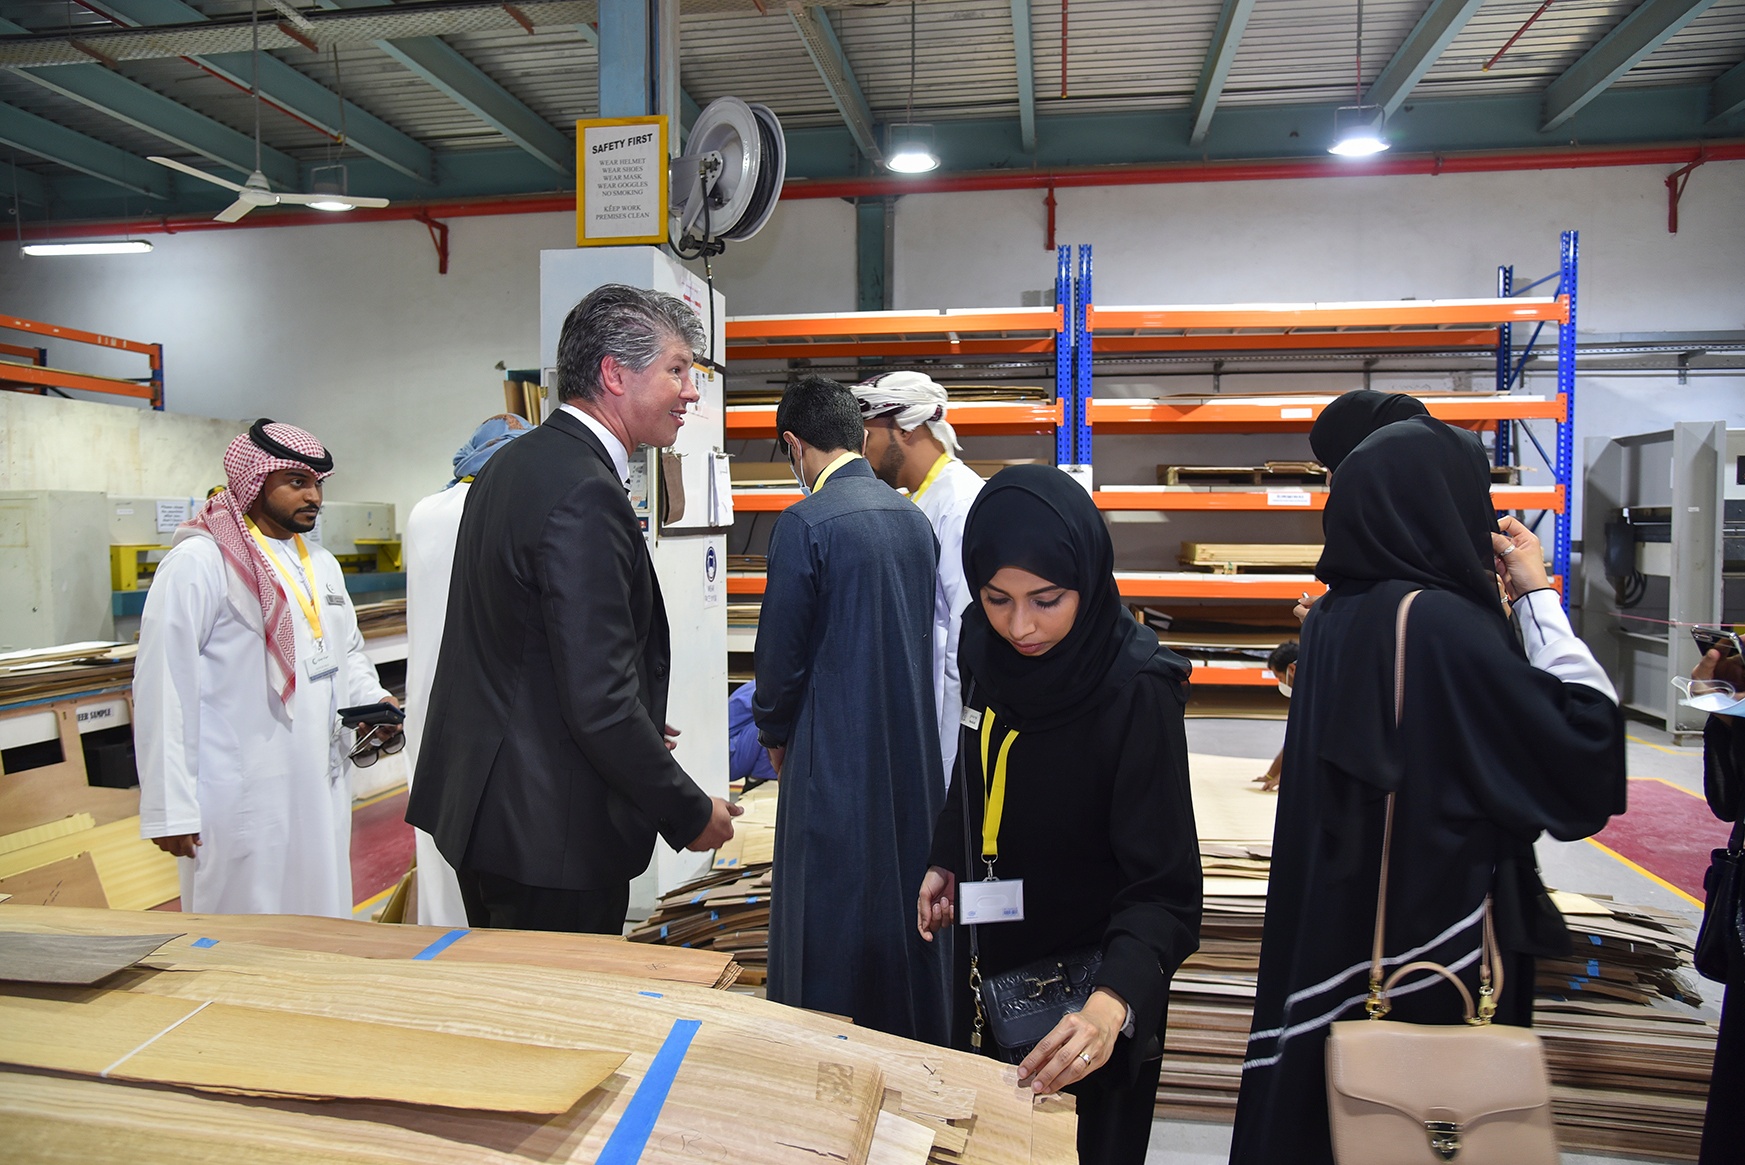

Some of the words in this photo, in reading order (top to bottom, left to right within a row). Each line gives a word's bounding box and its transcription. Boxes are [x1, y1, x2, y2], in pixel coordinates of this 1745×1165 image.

[592, 139, 625, 154] SAFETY
[628, 134, 653, 146] FIRST
[77, 713, 89, 722] EER
[90, 708, 111, 719] SAMPLE
